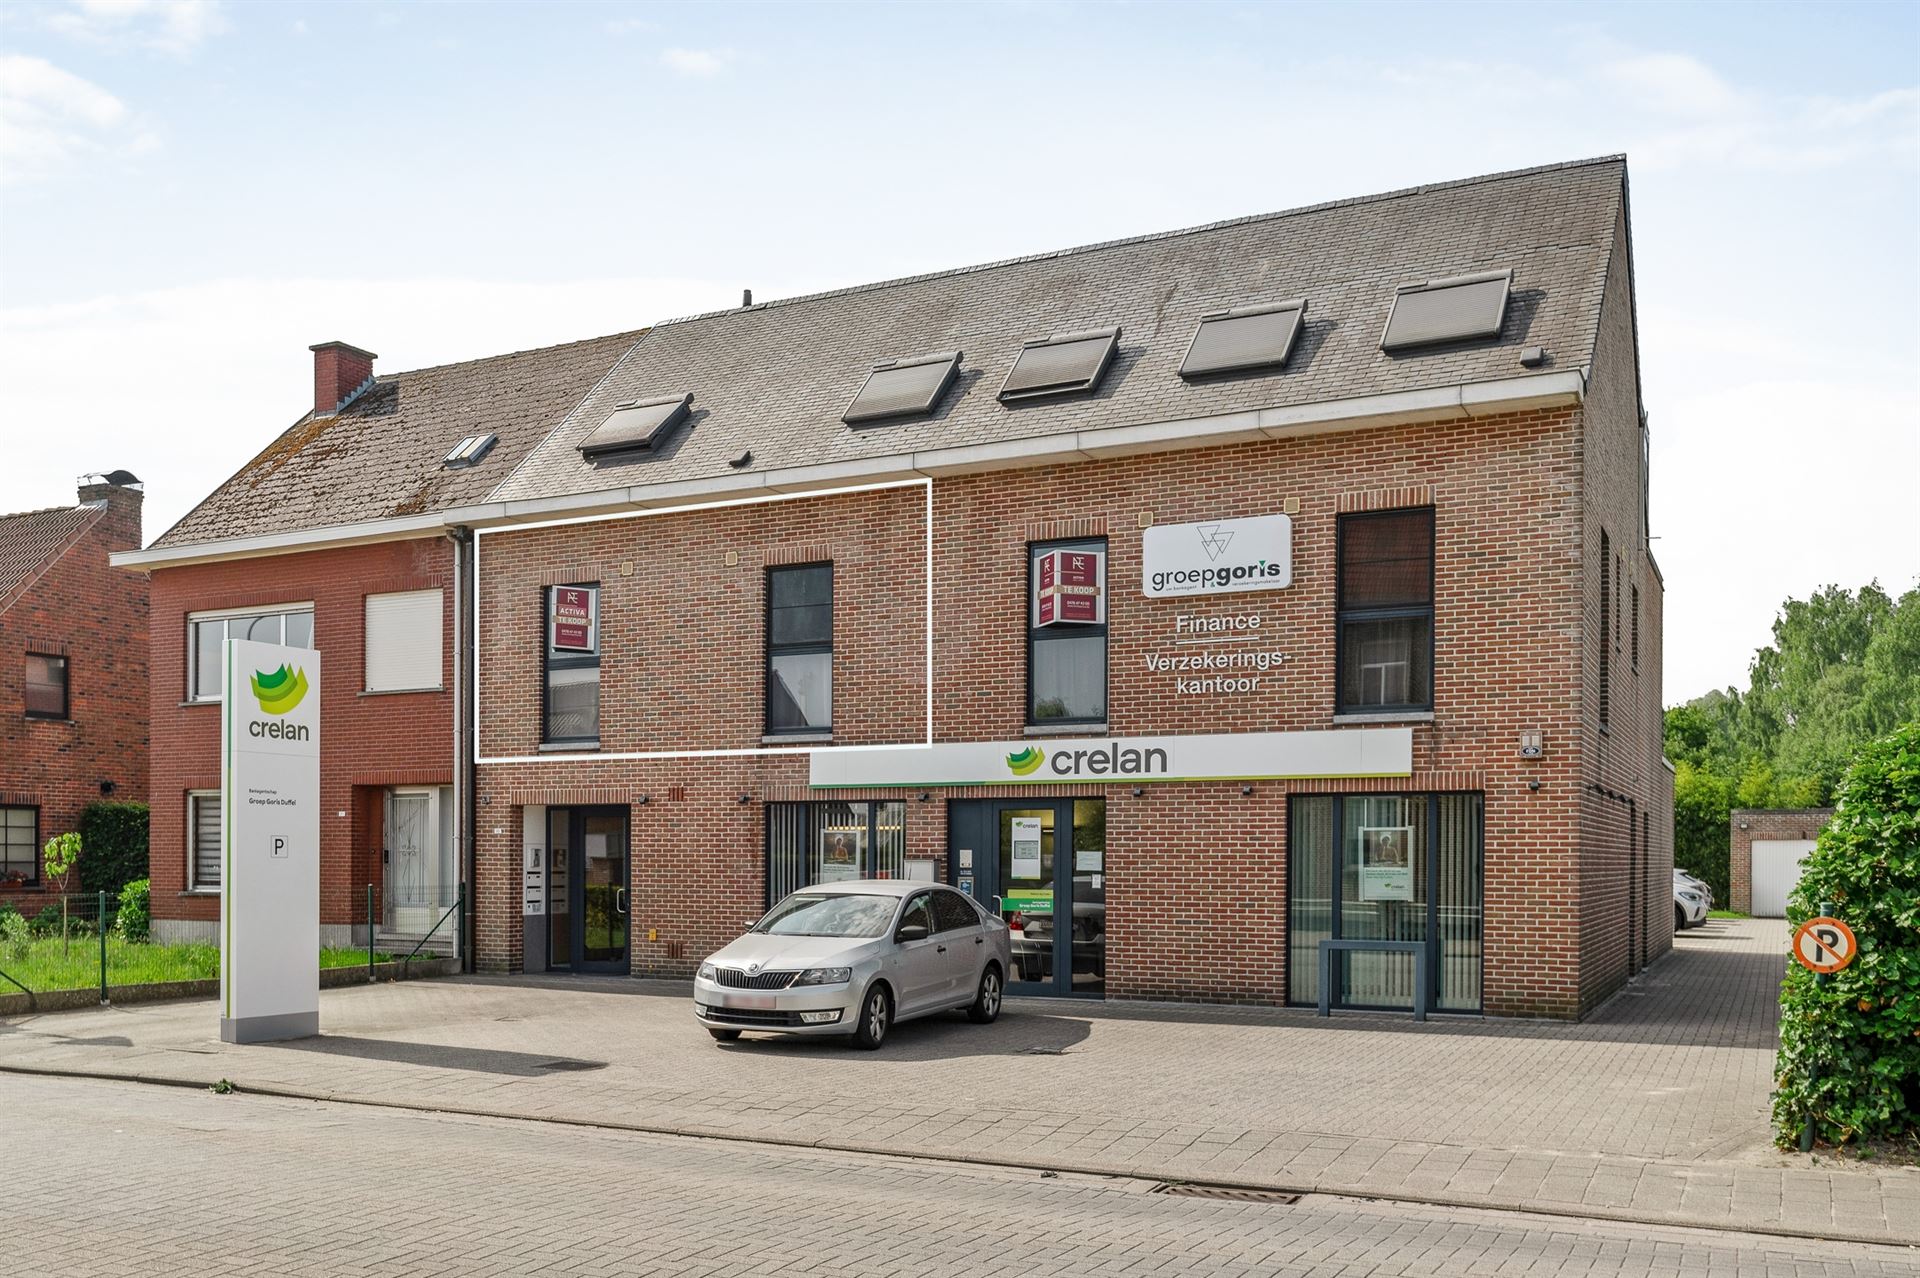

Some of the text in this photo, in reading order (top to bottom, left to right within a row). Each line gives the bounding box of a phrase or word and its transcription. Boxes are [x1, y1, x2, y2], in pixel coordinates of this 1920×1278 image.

[1152, 560, 1281, 592] groepgoris
[1073, 586, 1095, 594] KOOP
[560, 607, 585, 616] ACTIVA
[567, 617, 587, 625] KOOP
[1176, 614, 1261, 633] Finance
[1145, 650, 1292, 671] Verzekerings-
[1177, 676, 1260, 694] kantoor
[249, 718, 310, 742] crelan
[1051, 742, 1168, 775] crelan
[248, 797, 266, 806] Groep
[275, 838, 285, 855] P
